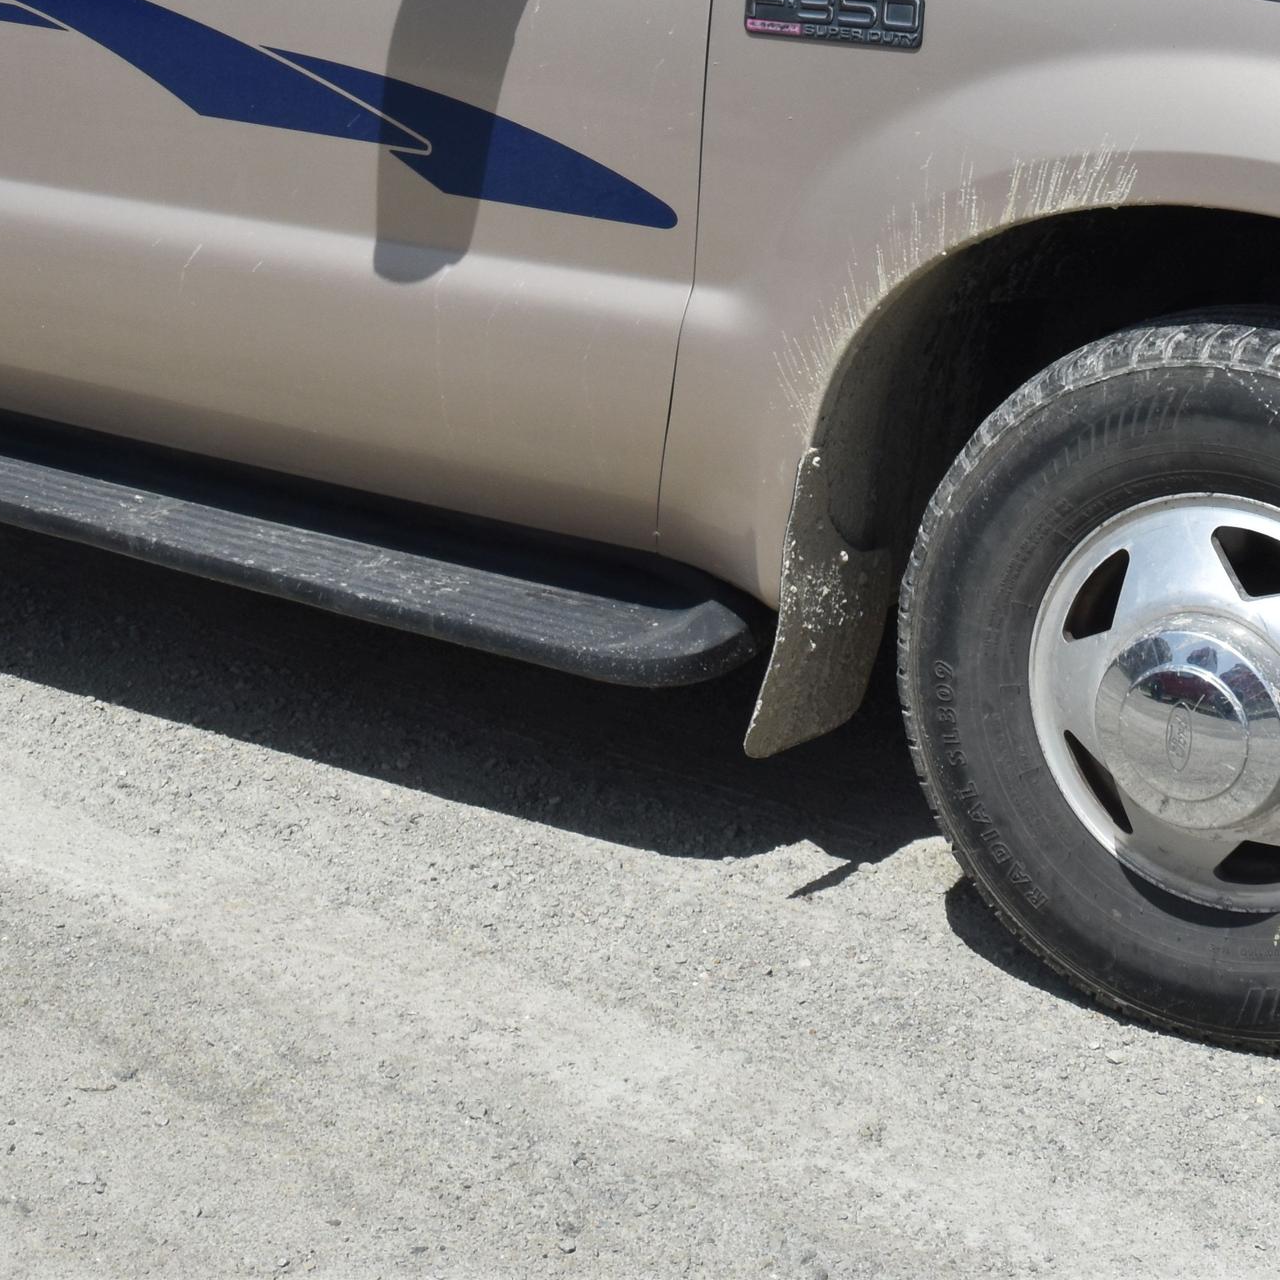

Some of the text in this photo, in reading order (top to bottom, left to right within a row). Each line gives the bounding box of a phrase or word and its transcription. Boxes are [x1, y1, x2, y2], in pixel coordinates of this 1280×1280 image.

[803, 23, 864, 41] SUPER
[869, 29, 919, 47] DUTY
[933, 659, 968, 768] SL309
[956, 779, 1050, 910] RADIAL
